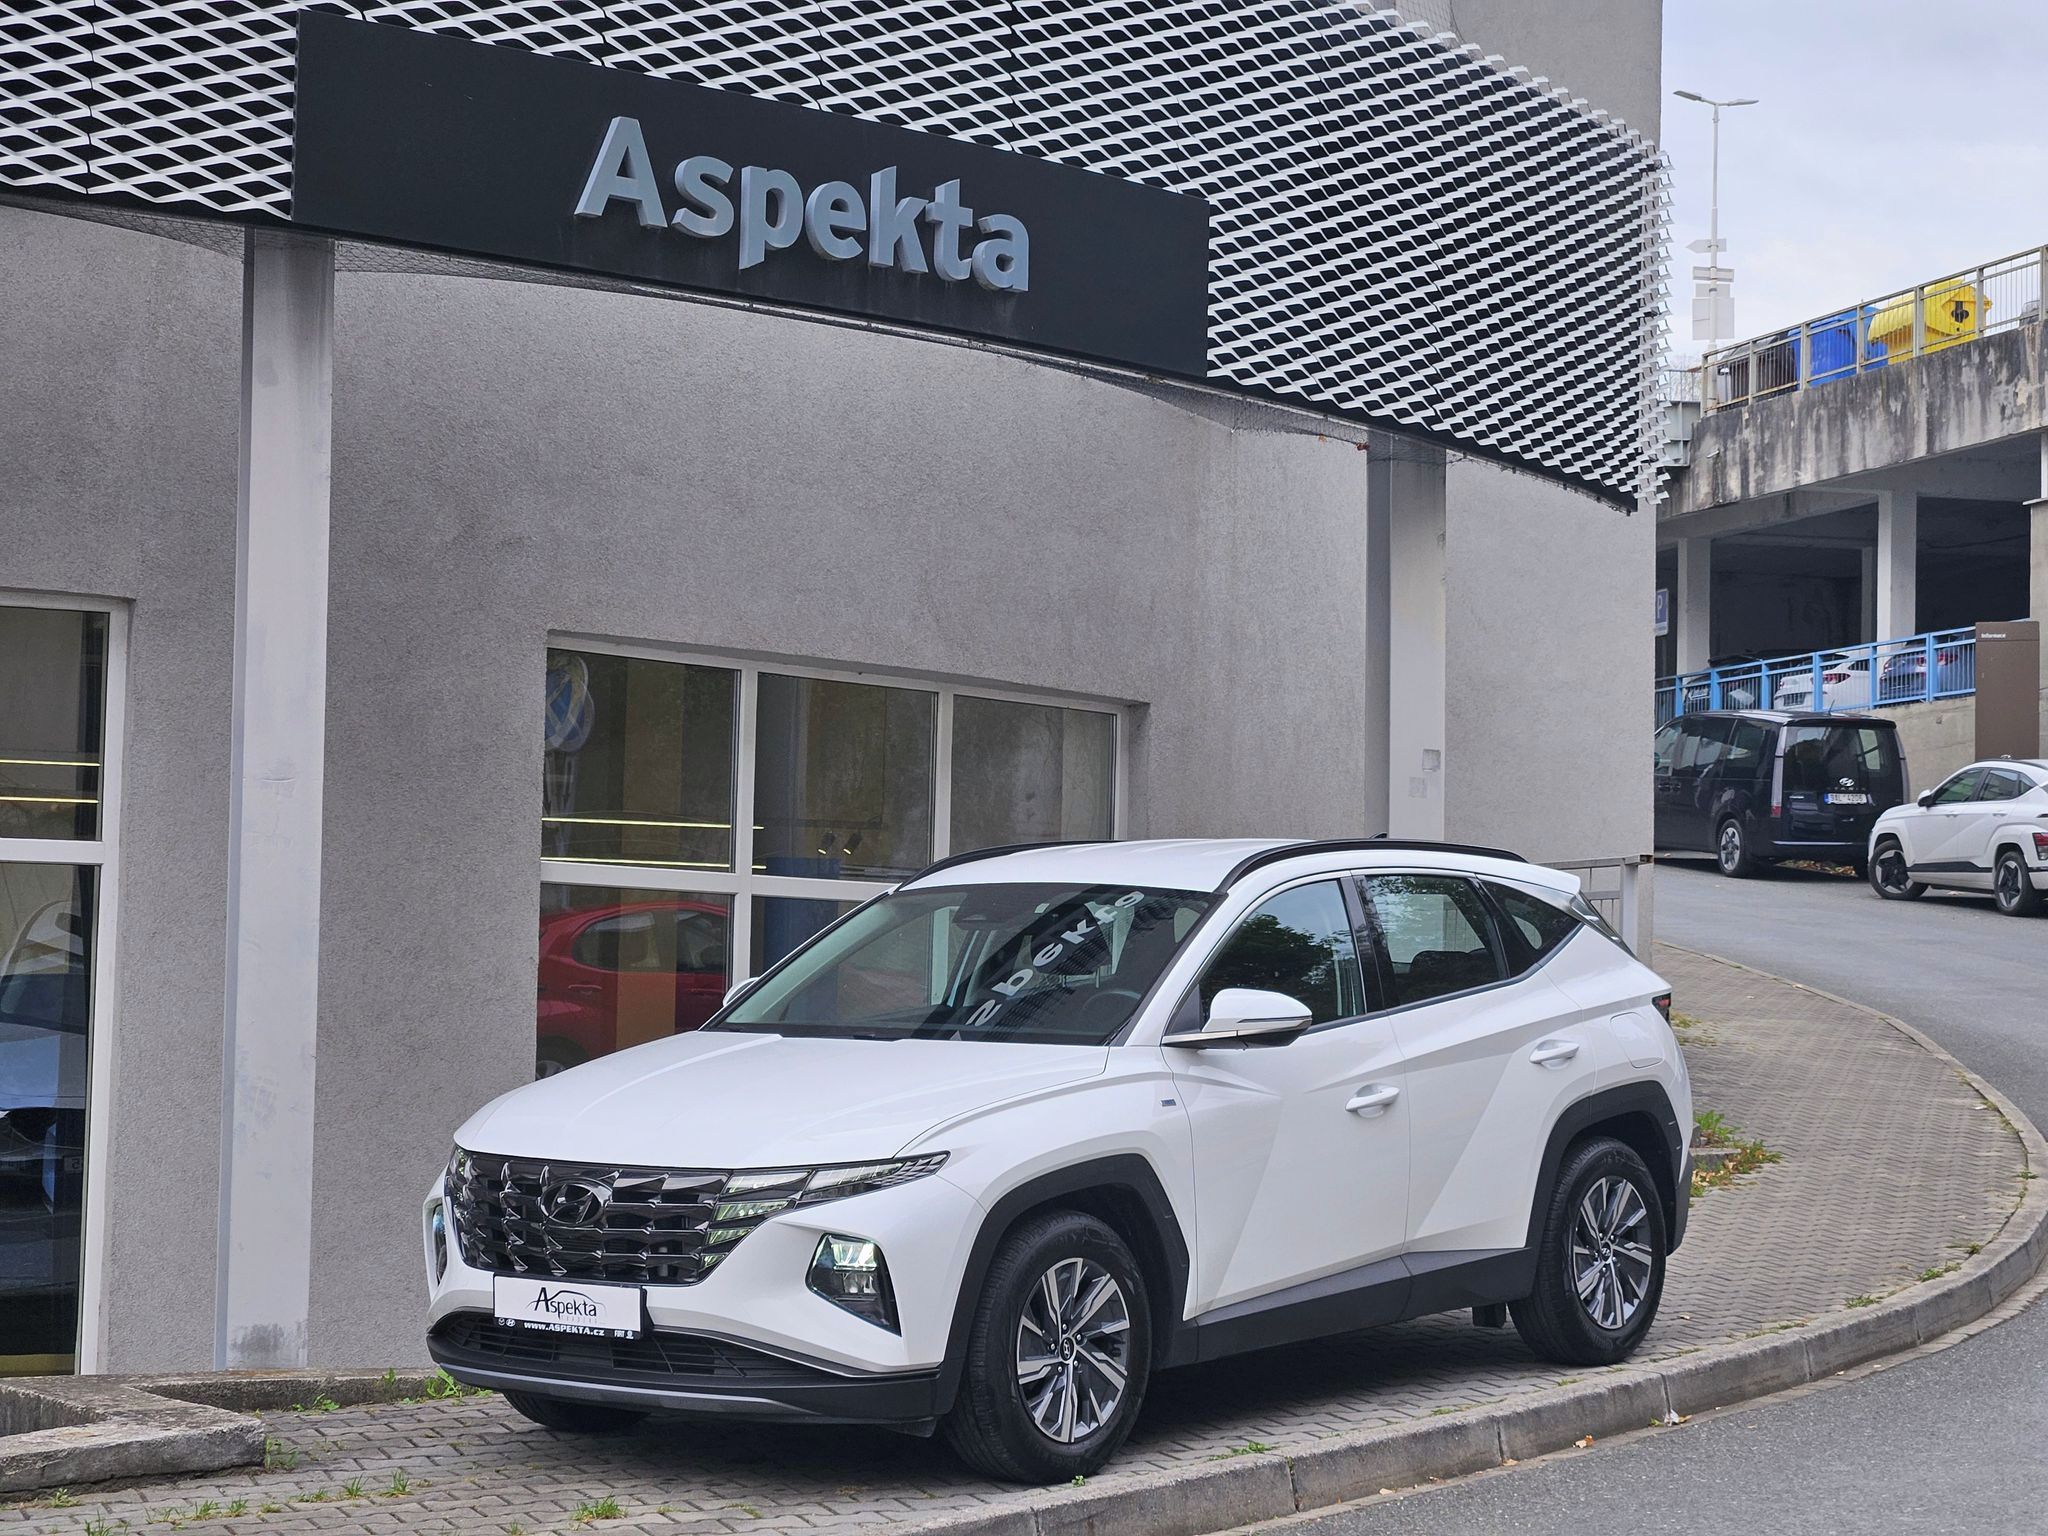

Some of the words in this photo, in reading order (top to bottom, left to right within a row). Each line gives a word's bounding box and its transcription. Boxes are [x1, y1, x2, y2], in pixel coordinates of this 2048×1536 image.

[574, 116, 1030, 292] Aspekta
[1657, 594, 1663, 619] P
[534, 1287, 597, 1319] Aspekta
[523, 1321, 605, 1336] www.ASPEKTA.cz
